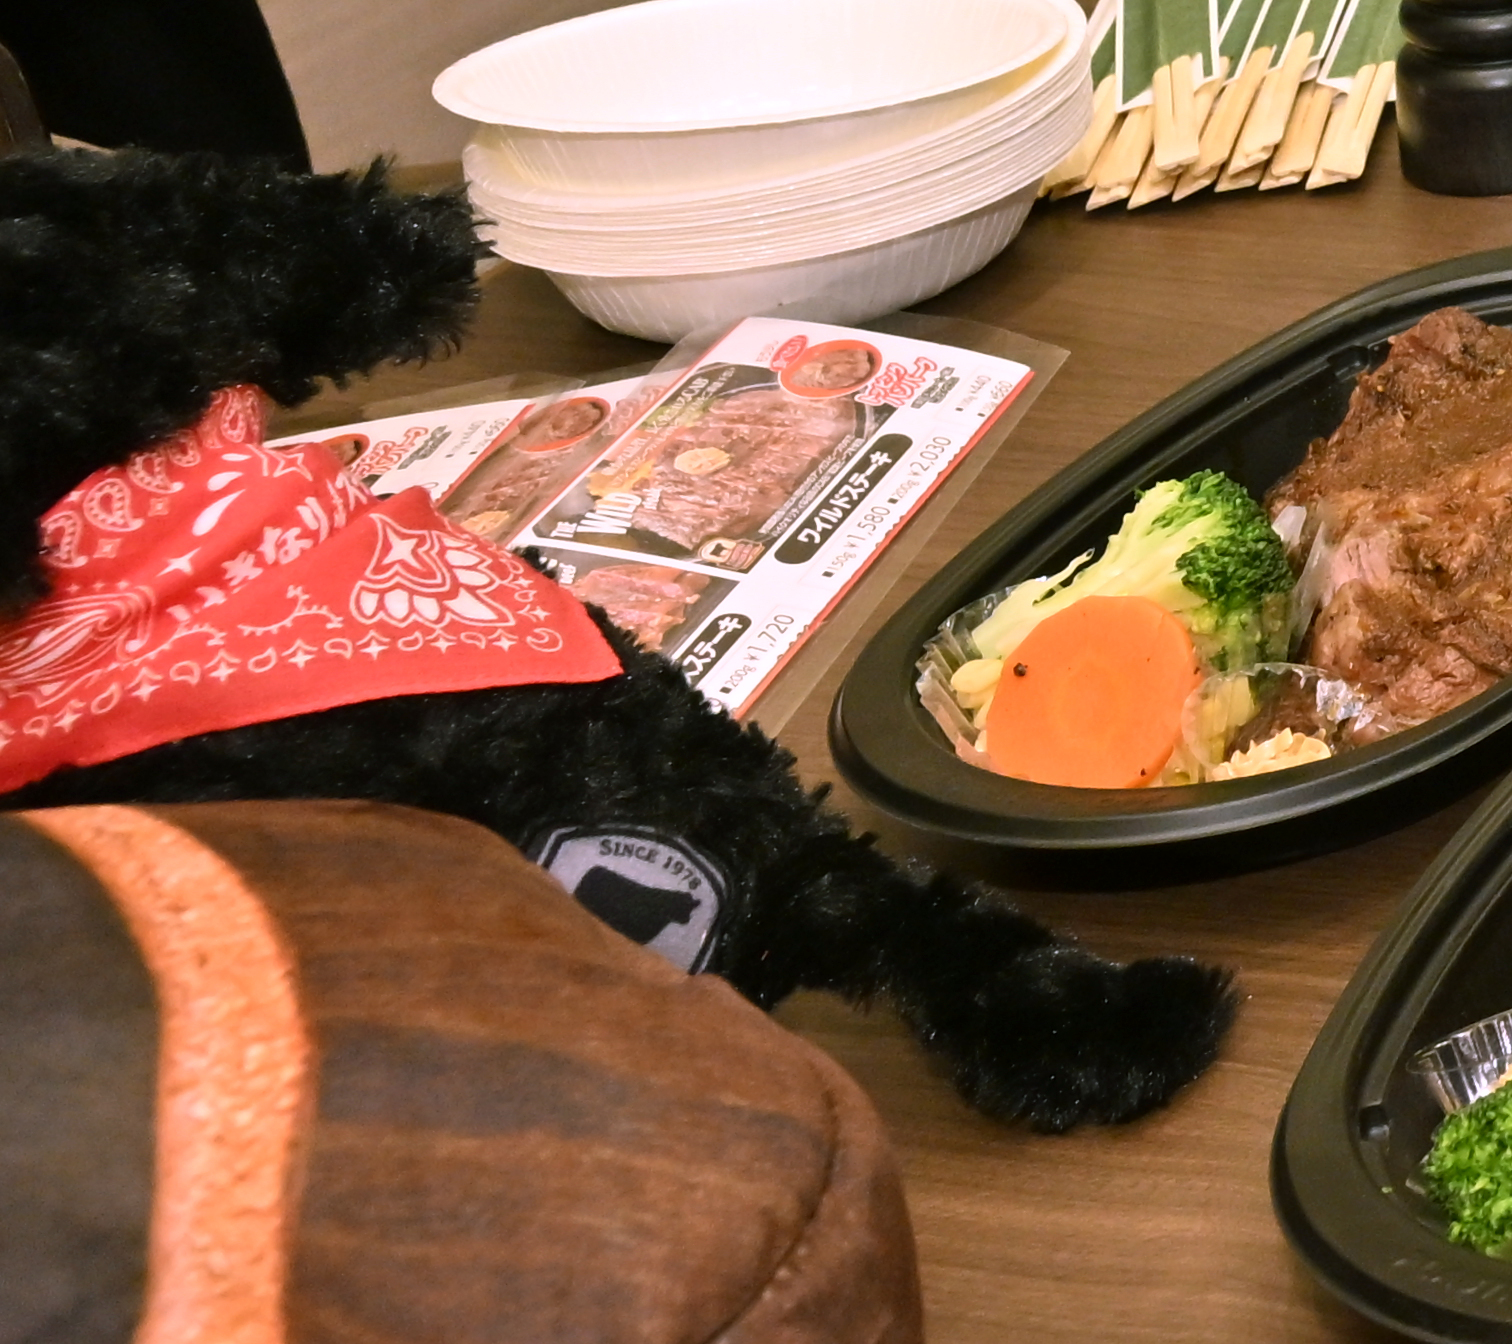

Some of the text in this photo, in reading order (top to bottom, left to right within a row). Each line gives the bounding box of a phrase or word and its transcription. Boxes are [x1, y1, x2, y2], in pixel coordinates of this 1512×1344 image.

[576, 492, 642, 534] WILD
[796, 450, 893, 544] ワイルドステーキ
[846, 505, 891, 550] ¥1,580
[910, 436, 952, 480] ¥2,030
[743, 614, 795, 664] ¥1,720
[600, 838, 701, 891] SINCE 1978
